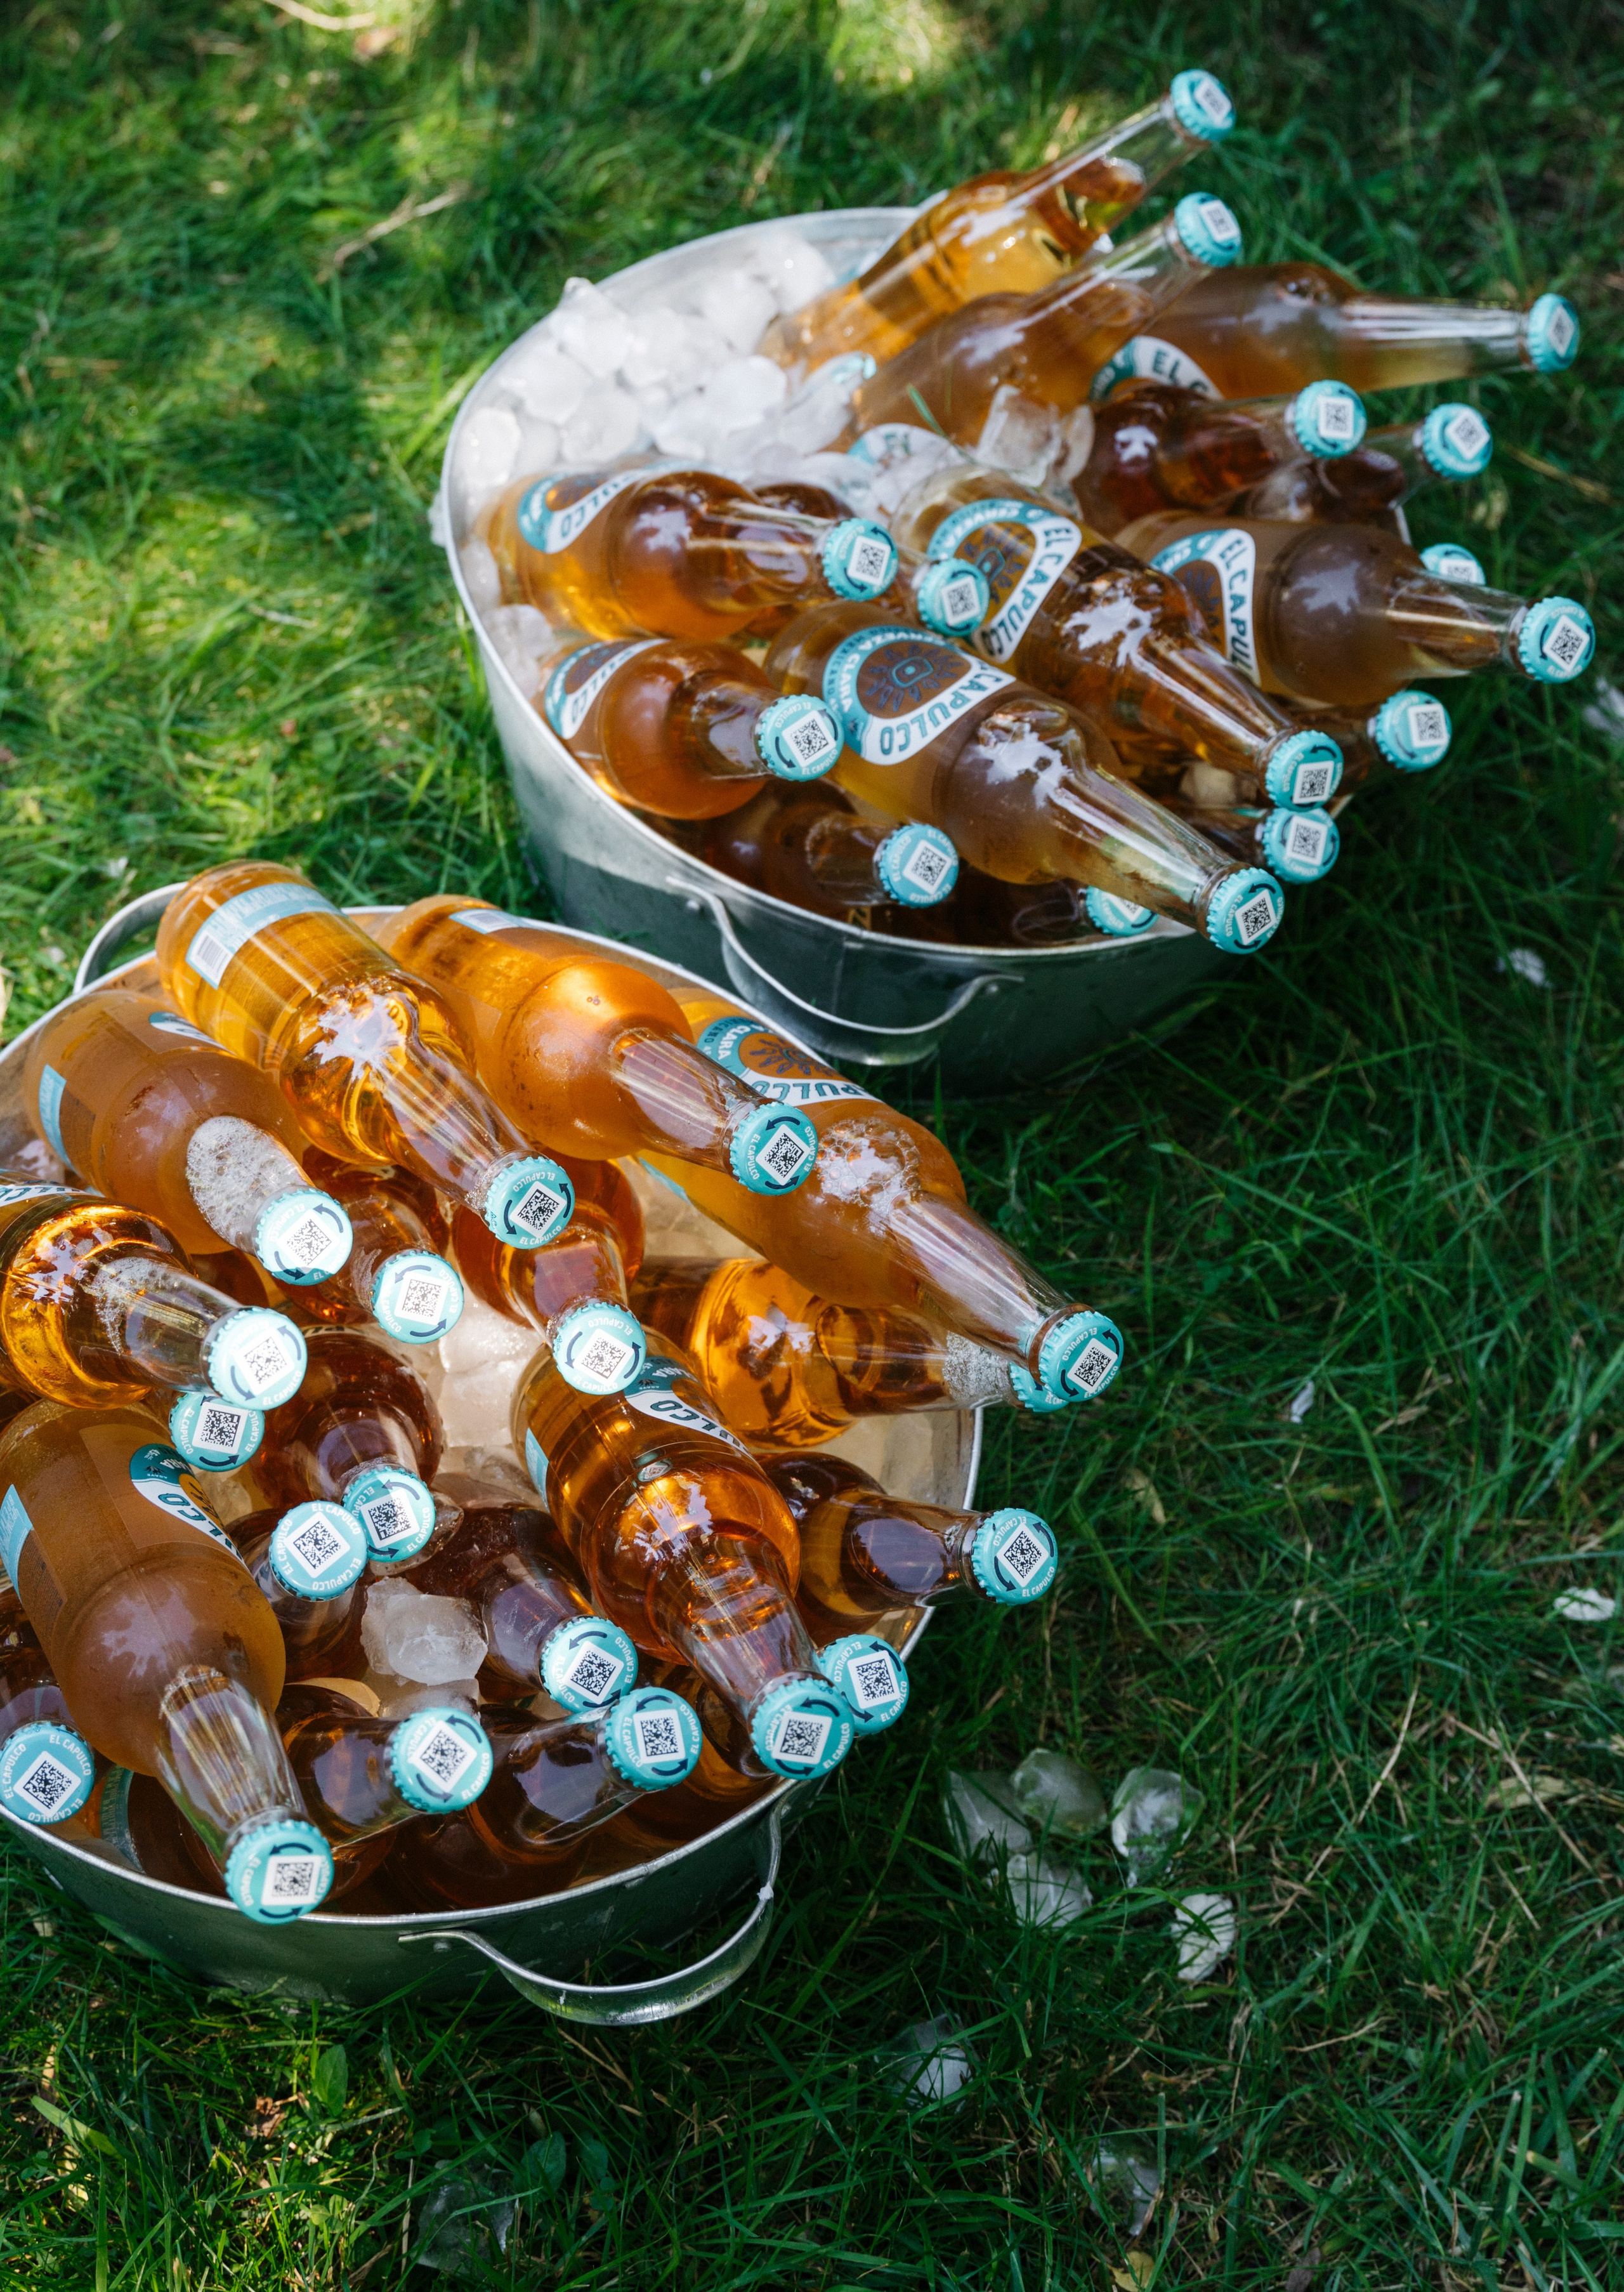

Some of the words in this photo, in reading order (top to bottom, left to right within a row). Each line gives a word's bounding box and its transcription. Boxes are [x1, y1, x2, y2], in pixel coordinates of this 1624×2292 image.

[1153, 349, 1181, 385] EL
[1044, 527, 1073, 548] EL
[1219, 536, 1248, 570] EL
[1228, 568, 1253, 670] CAPUL
[838, 653, 860, 712] CLARA
[775, 703, 802, 728] CAPULCO
[802, 702, 811, 711] EL
[879, 669, 1004, 756] CAPULCO
[813, 749, 838, 774] CAPULCO
[1226, 902, 1238, 937] CAPULCO
[717, 1024, 750, 1060] CLARA
[752, 1080, 861, 1102] PULCO
[753, 1133, 761, 1144] EL
[804, 1126, 815, 1162] CAPULCO
[747, 1144, 760, 1180] CAPULCO
[804, 1162, 813, 1172] EL
[513, 1171, 546, 1192] CAPULCO
[546, 1172, 556, 1181] EL
[520, 1236, 528, 1245] EL
[530, 1225, 561, 1245] CAPULCO
[587, 1317, 624, 1328] CAPULCO
[623, 1326, 633, 1336] EL
[1088, 1327, 1097, 1336] EL
[1061, 1330, 1089, 1361] CAPULCO
[263, 1397, 273, 1406] EL
[273, 1371, 303, 1401] CAPULCO
[573, 1376, 582, 1386] EL
[583, 1381, 618, 1392] CAPULCO
[1092, 1366, 1119, 1397] CAPULCO
[186, 1407, 195, 1420] EL
[247, 1409, 259, 1442] CAPULC
[180, 1420, 193, 1454] CAPULCO
[244, 1441, 254, 1452] EL
[366, 1486, 376, 1496] EL
[311, 1503, 324, 1512] EL
[325, 1504, 361, 1535] CAPULCO
[406, 1543, 416, 1553] EL
[413, 1507, 431, 1545] CAPULCO
[992, 1518, 1018, 1546] CAPULCO
[278, 1518, 294, 1560] CAPULCO
[281, 1560, 294, 1574] EL
[351, 1557, 362, 1570] EL
[312, 1569, 353, 1591] CAPULCO
[1022, 1589, 1031, 1597] EL
[1031, 1566, 1056, 1594] CAPULCO
[615, 1637, 634, 1675] CAPULCO
[852, 1641, 863, 1650] EL
[557, 1656, 566, 1668] EL
[833, 1647, 853, 1682] CAPULCO
[624, 1673, 632, 1684] EL
[880, 1712, 891, 1722] EL
[889, 1680, 907, 1715] CAPULCO
[624, 1716, 633, 1729] EL
[679, 1703, 700, 1742] CAPULCO
[49, 1734, 61, 1744] EL
[62, 1739, 92, 1776] CAPULCO
[622, 1729, 642, 1768] CAPULCO
[690, 1742, 699, 1754] EL
[823, 1759, 834, 1769] EL
[832, 1722, 850, 1761] CAPULCO
[1, 1743, 27, 1788] CAPULCO
[461, 1790, 473, 1800] EL
[472, 1752, 490, 1793] CAPULCO
[3, 1787, 15, 1800] EL
[70, 1798, 84, 1809] EL
[28, 1808, 73, 1823] CAPULCO
